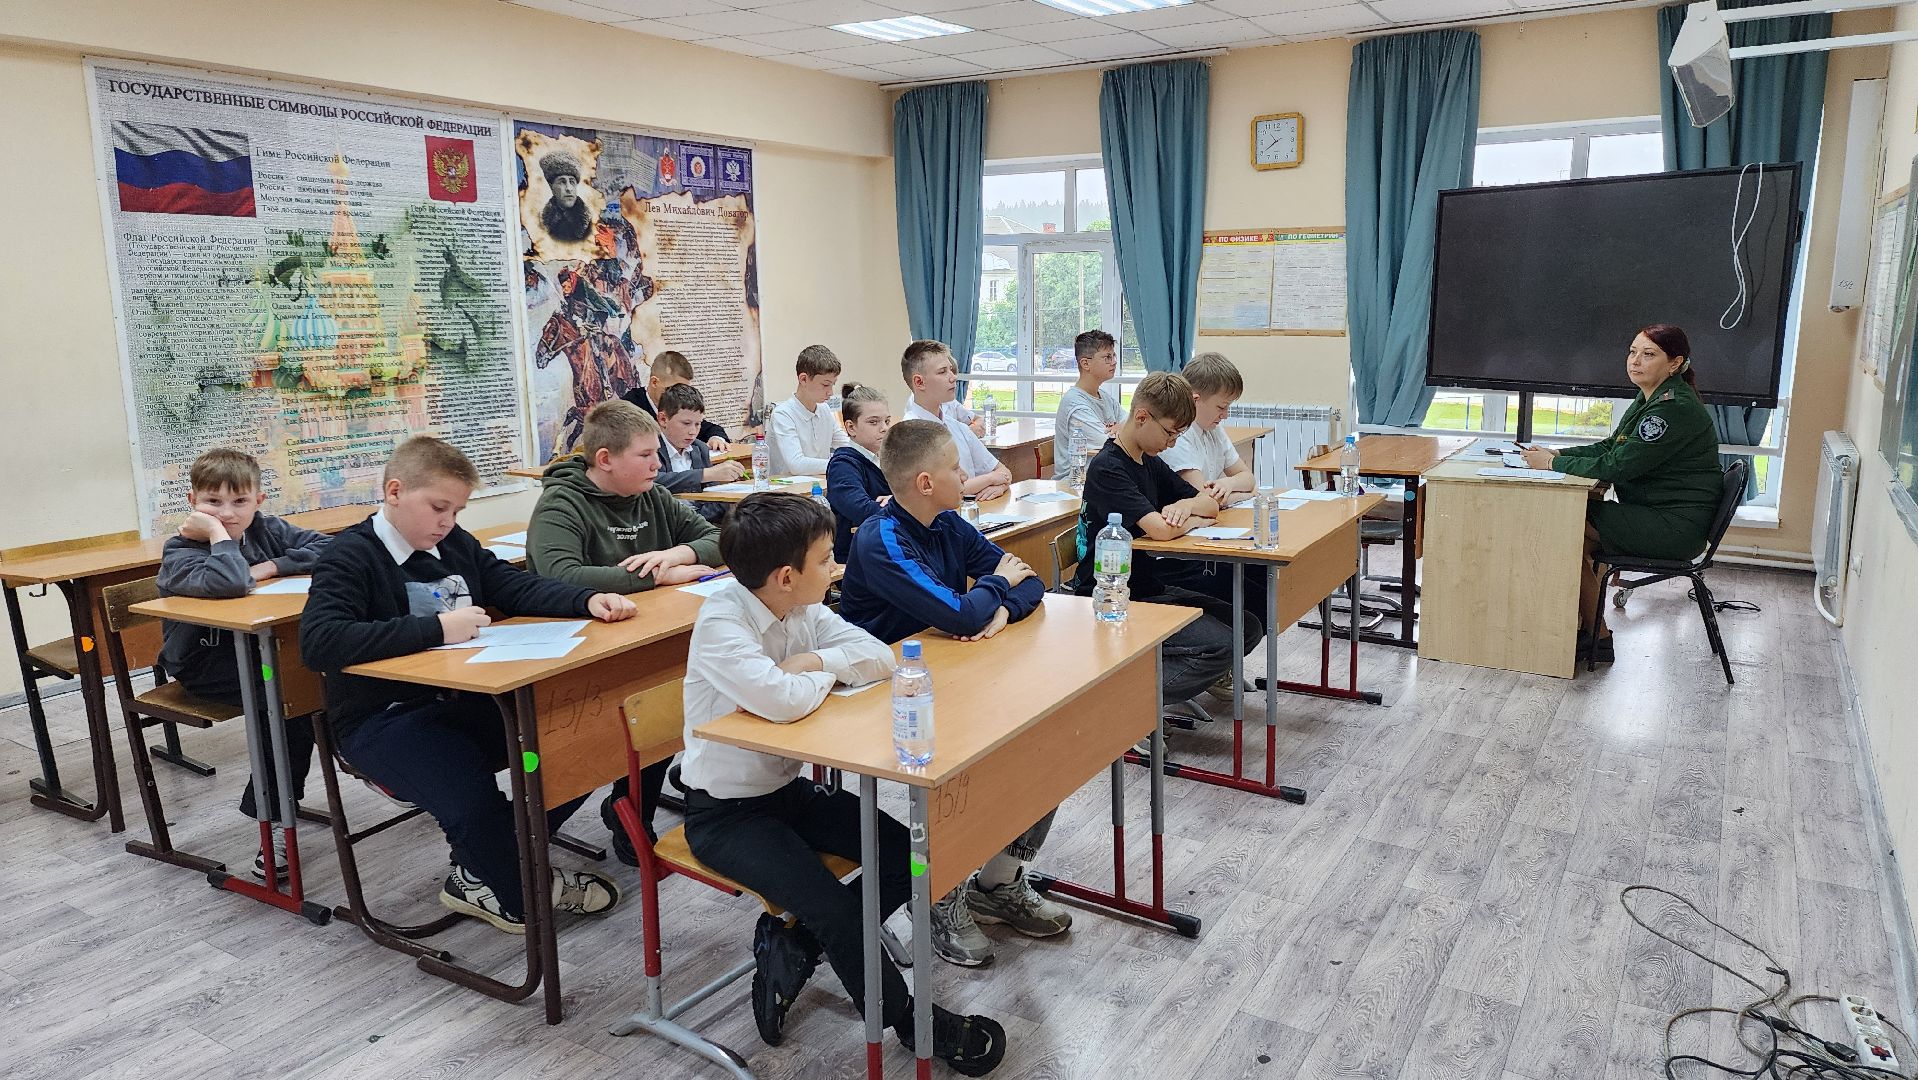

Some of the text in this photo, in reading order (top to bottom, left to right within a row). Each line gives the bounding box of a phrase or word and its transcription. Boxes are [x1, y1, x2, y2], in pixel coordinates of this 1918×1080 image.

[108, 79, 492, 137] ГОСУДАРСТВЕННЫЕ СИМВОЛЫ РОССИЙСКОЙ ФЕДЕРАЦИИ
[645, 202, 749, 221] Лев Михайлович Доватор
[124, 233, 258, 245] Флаг Российской Федерации
[1298, 232, 1339, 240] ГЕОМЕТРИИ
